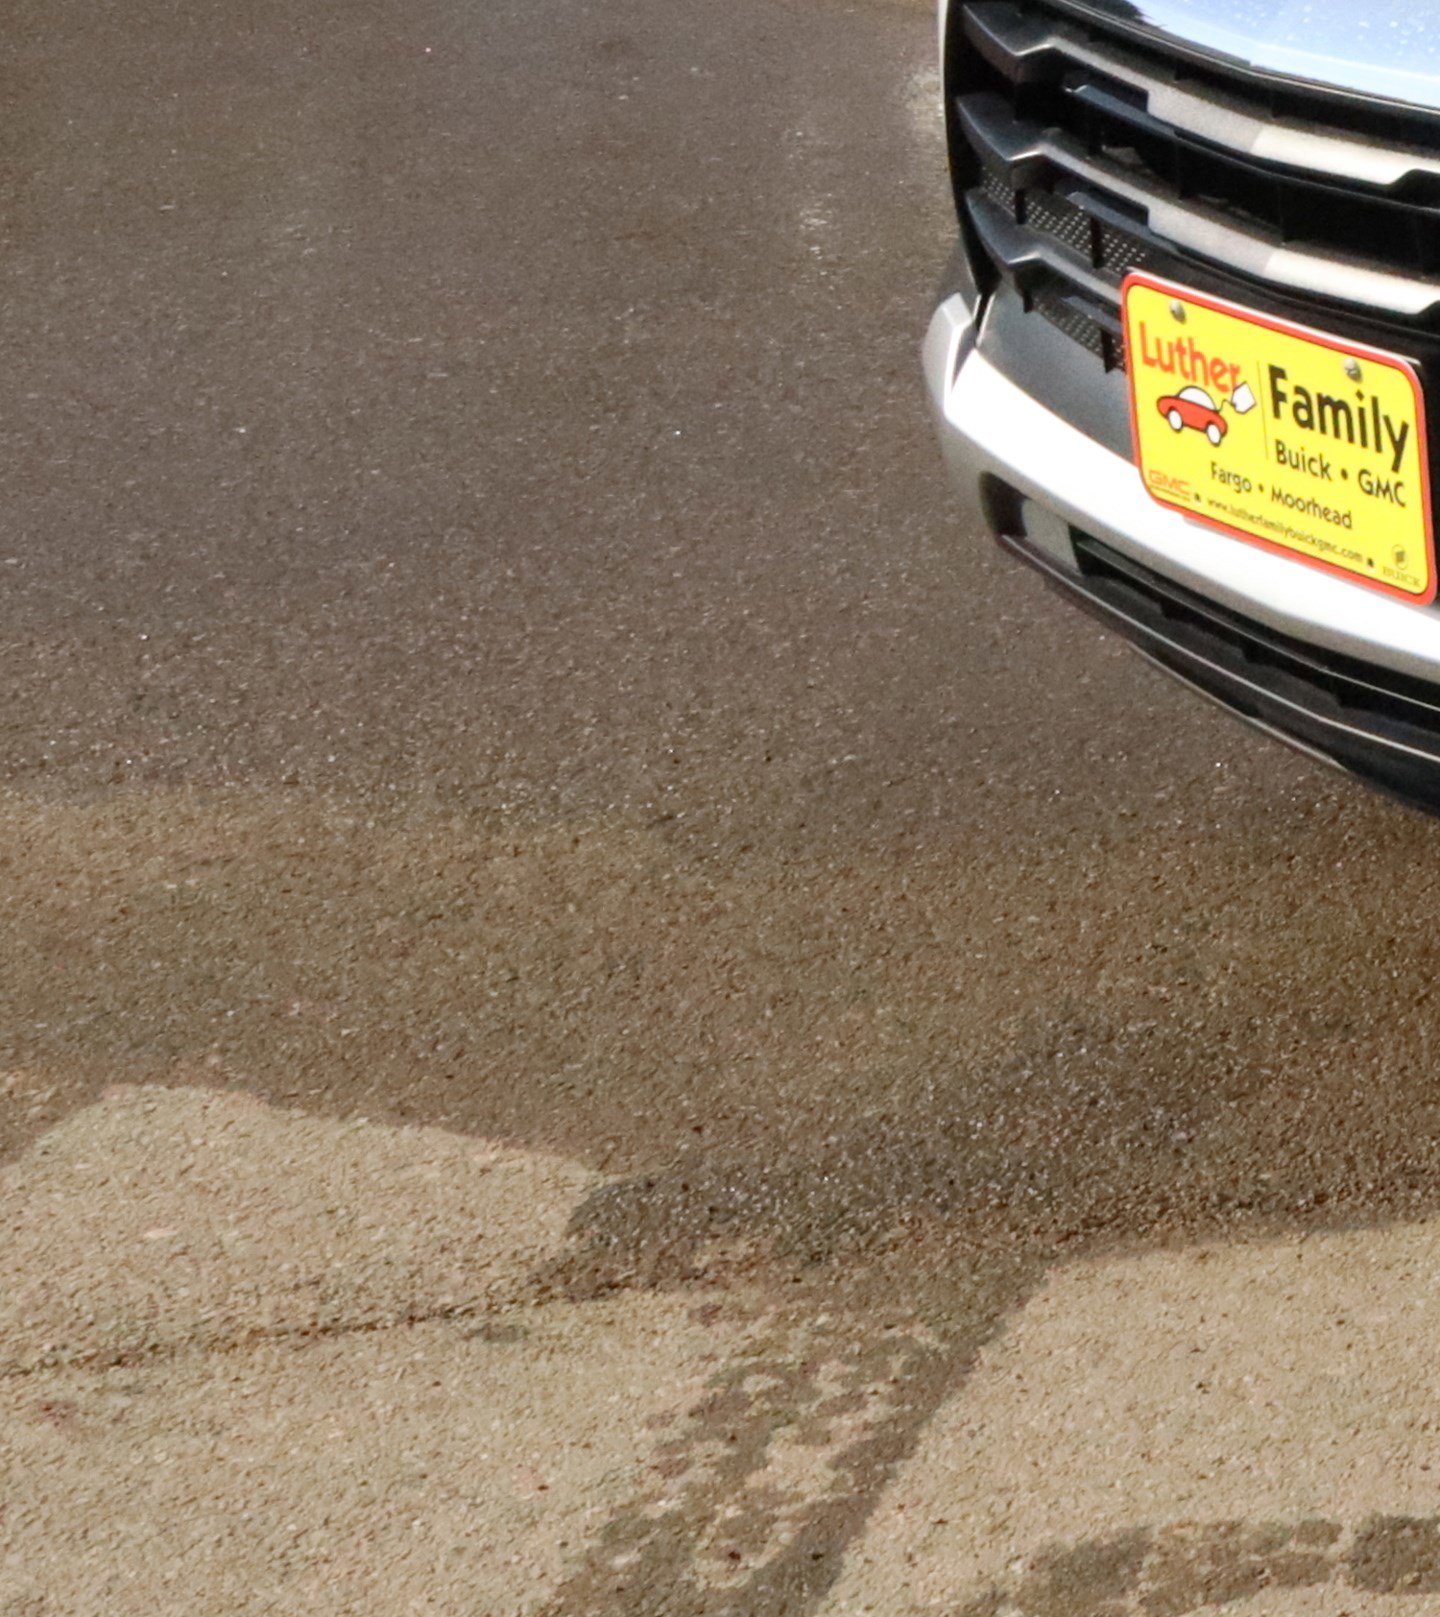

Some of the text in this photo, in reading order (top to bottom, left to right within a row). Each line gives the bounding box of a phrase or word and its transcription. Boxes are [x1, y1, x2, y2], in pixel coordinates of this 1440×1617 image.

[1138, 319, 1242, 394] Luther
[1268, 363, 1410, 474] Family
[1210, 461, 1253, 494] Fargo
[1270, 484, 1353, 530] Moorhead
[1275, 438, 1407, 508] Buick GMC
